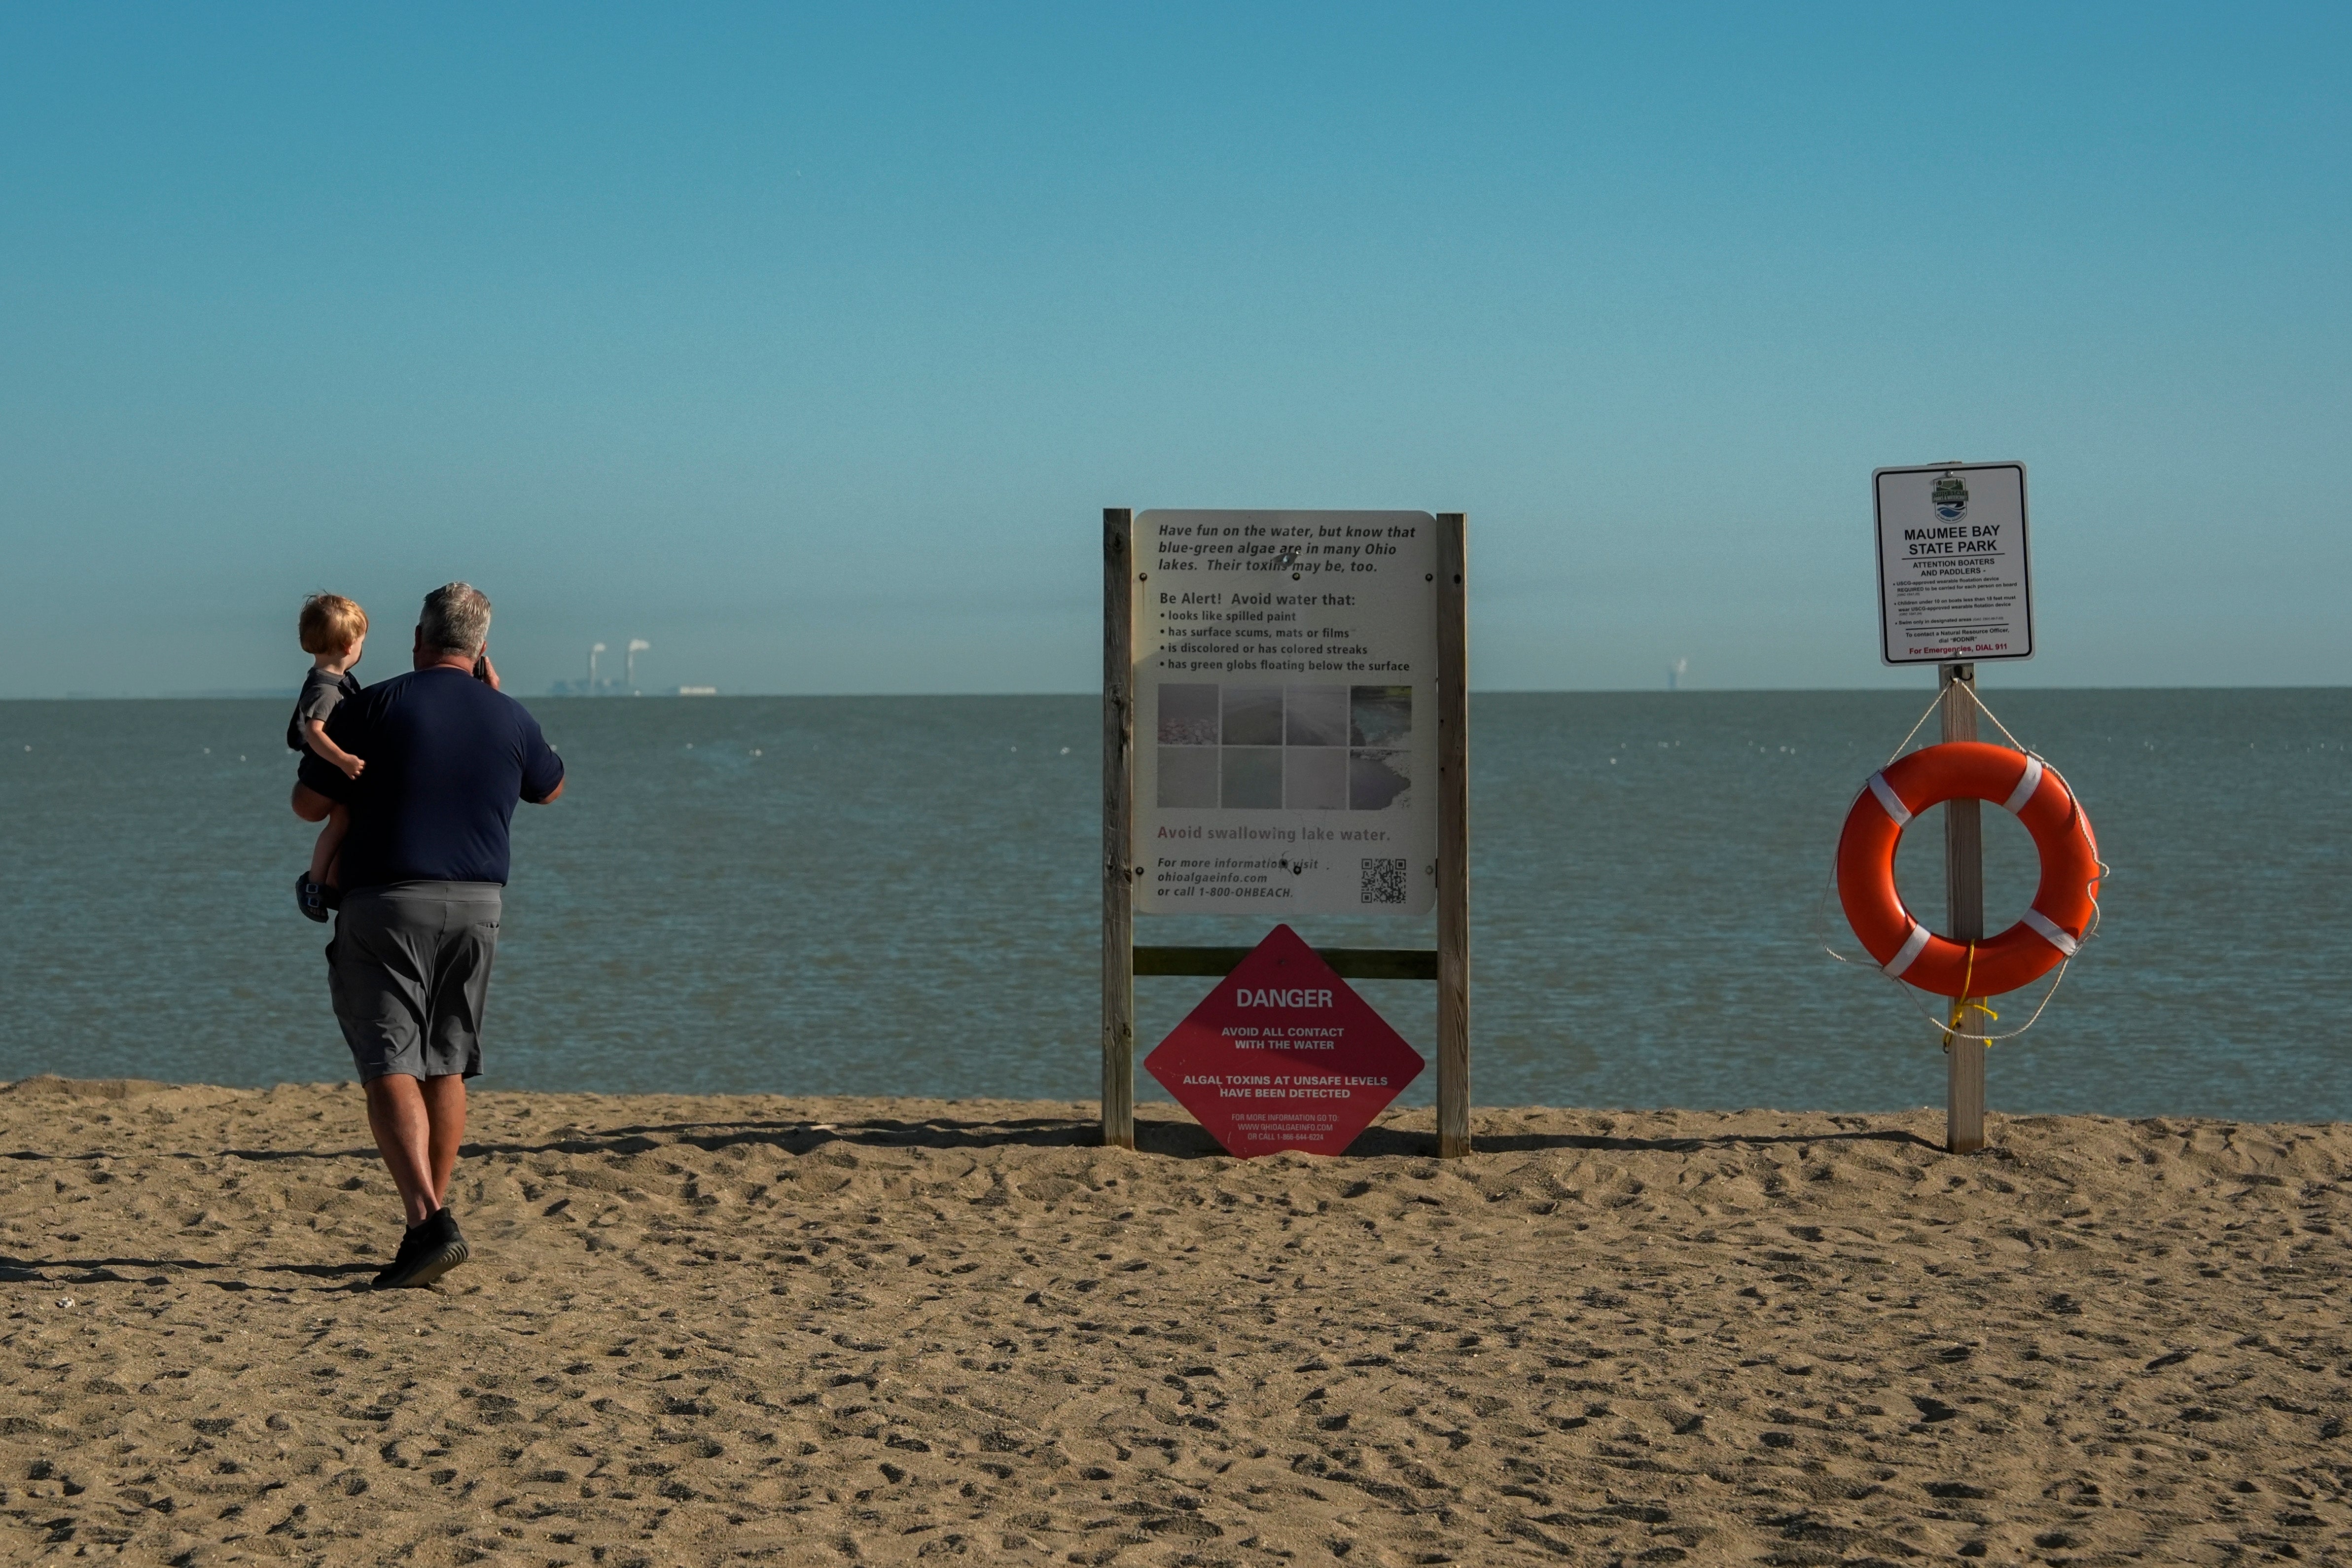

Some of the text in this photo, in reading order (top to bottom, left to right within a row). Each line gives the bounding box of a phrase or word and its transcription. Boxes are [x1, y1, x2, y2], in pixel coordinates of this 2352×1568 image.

[1159, 525, 1191, 535] Have
[1197, 524, 1218, 535] fun
[1245, 525, 1265, 536] the
[1271, 527, 1314, 538] water,
[1319, 526, 1342, 537] but
[1346, 526, 1383, 537] know
[1388, 526, 1415, 537] that
[1905, 525, 2000, 540] MAUMEE BAY
[1159, 541, 1396, 557] blue-green algae are in many Ohio
[1909, 540, 1996, 555] STATE PARK
[1159, 559, 1197, 570] lakes.
[1208, 559, 1242, 570] Their
[1292, 561, 1320, 573] may
[1325, 560, 1344, 572] be,
[1351, 562, 1377, 571] too.
[1161, 592, 1354, 605] Be Alert! Avoid water that:
[1169, 610, 1295, 623] looks like spilled paint
[1169, 627, 1187, 636] has
[1191, 627, 1231, 637] surface
[1322, 628, 1349, 638] films
[1169, 643, 1176, 652] is
[1181, 643, 1239, 653] discolored
[1259, 643, 1277, 653] has
[1281, 644, 1322, 653] colored
[1327, 644, 1367, 654] streaks
[1169, 659, 1409, 672] has green globs floating below the surface
[1158, 825, 1390, 843] Avoid swallowing lake water.
[1158, 858, 1176, 867] For
[1215, 858, 1288, 869] informatio
[1158, 872, 1267, 884] ohioalgaeinfo.com
[1174, 887, 1195, 896] call
[1237, 989, 1332, 1007] DANGER
[1221, 1028, 1344, 1036] AVOID ALL CONTACT
[1268, 1040, 1290, 1049] THE
[1294, 1041, 1334, 1049] WATER
[1183, 1075, 1222, 1084] ALGAL
[1226, 1076, 1270, 1084] TOXINS
[1294, 1076, 1341, 1085] UNSAFE
[1345, 1077, 1387, 1085] LEVELS
[1220, 1088, 1350, 1098] HAVE BEEN DETECTED
